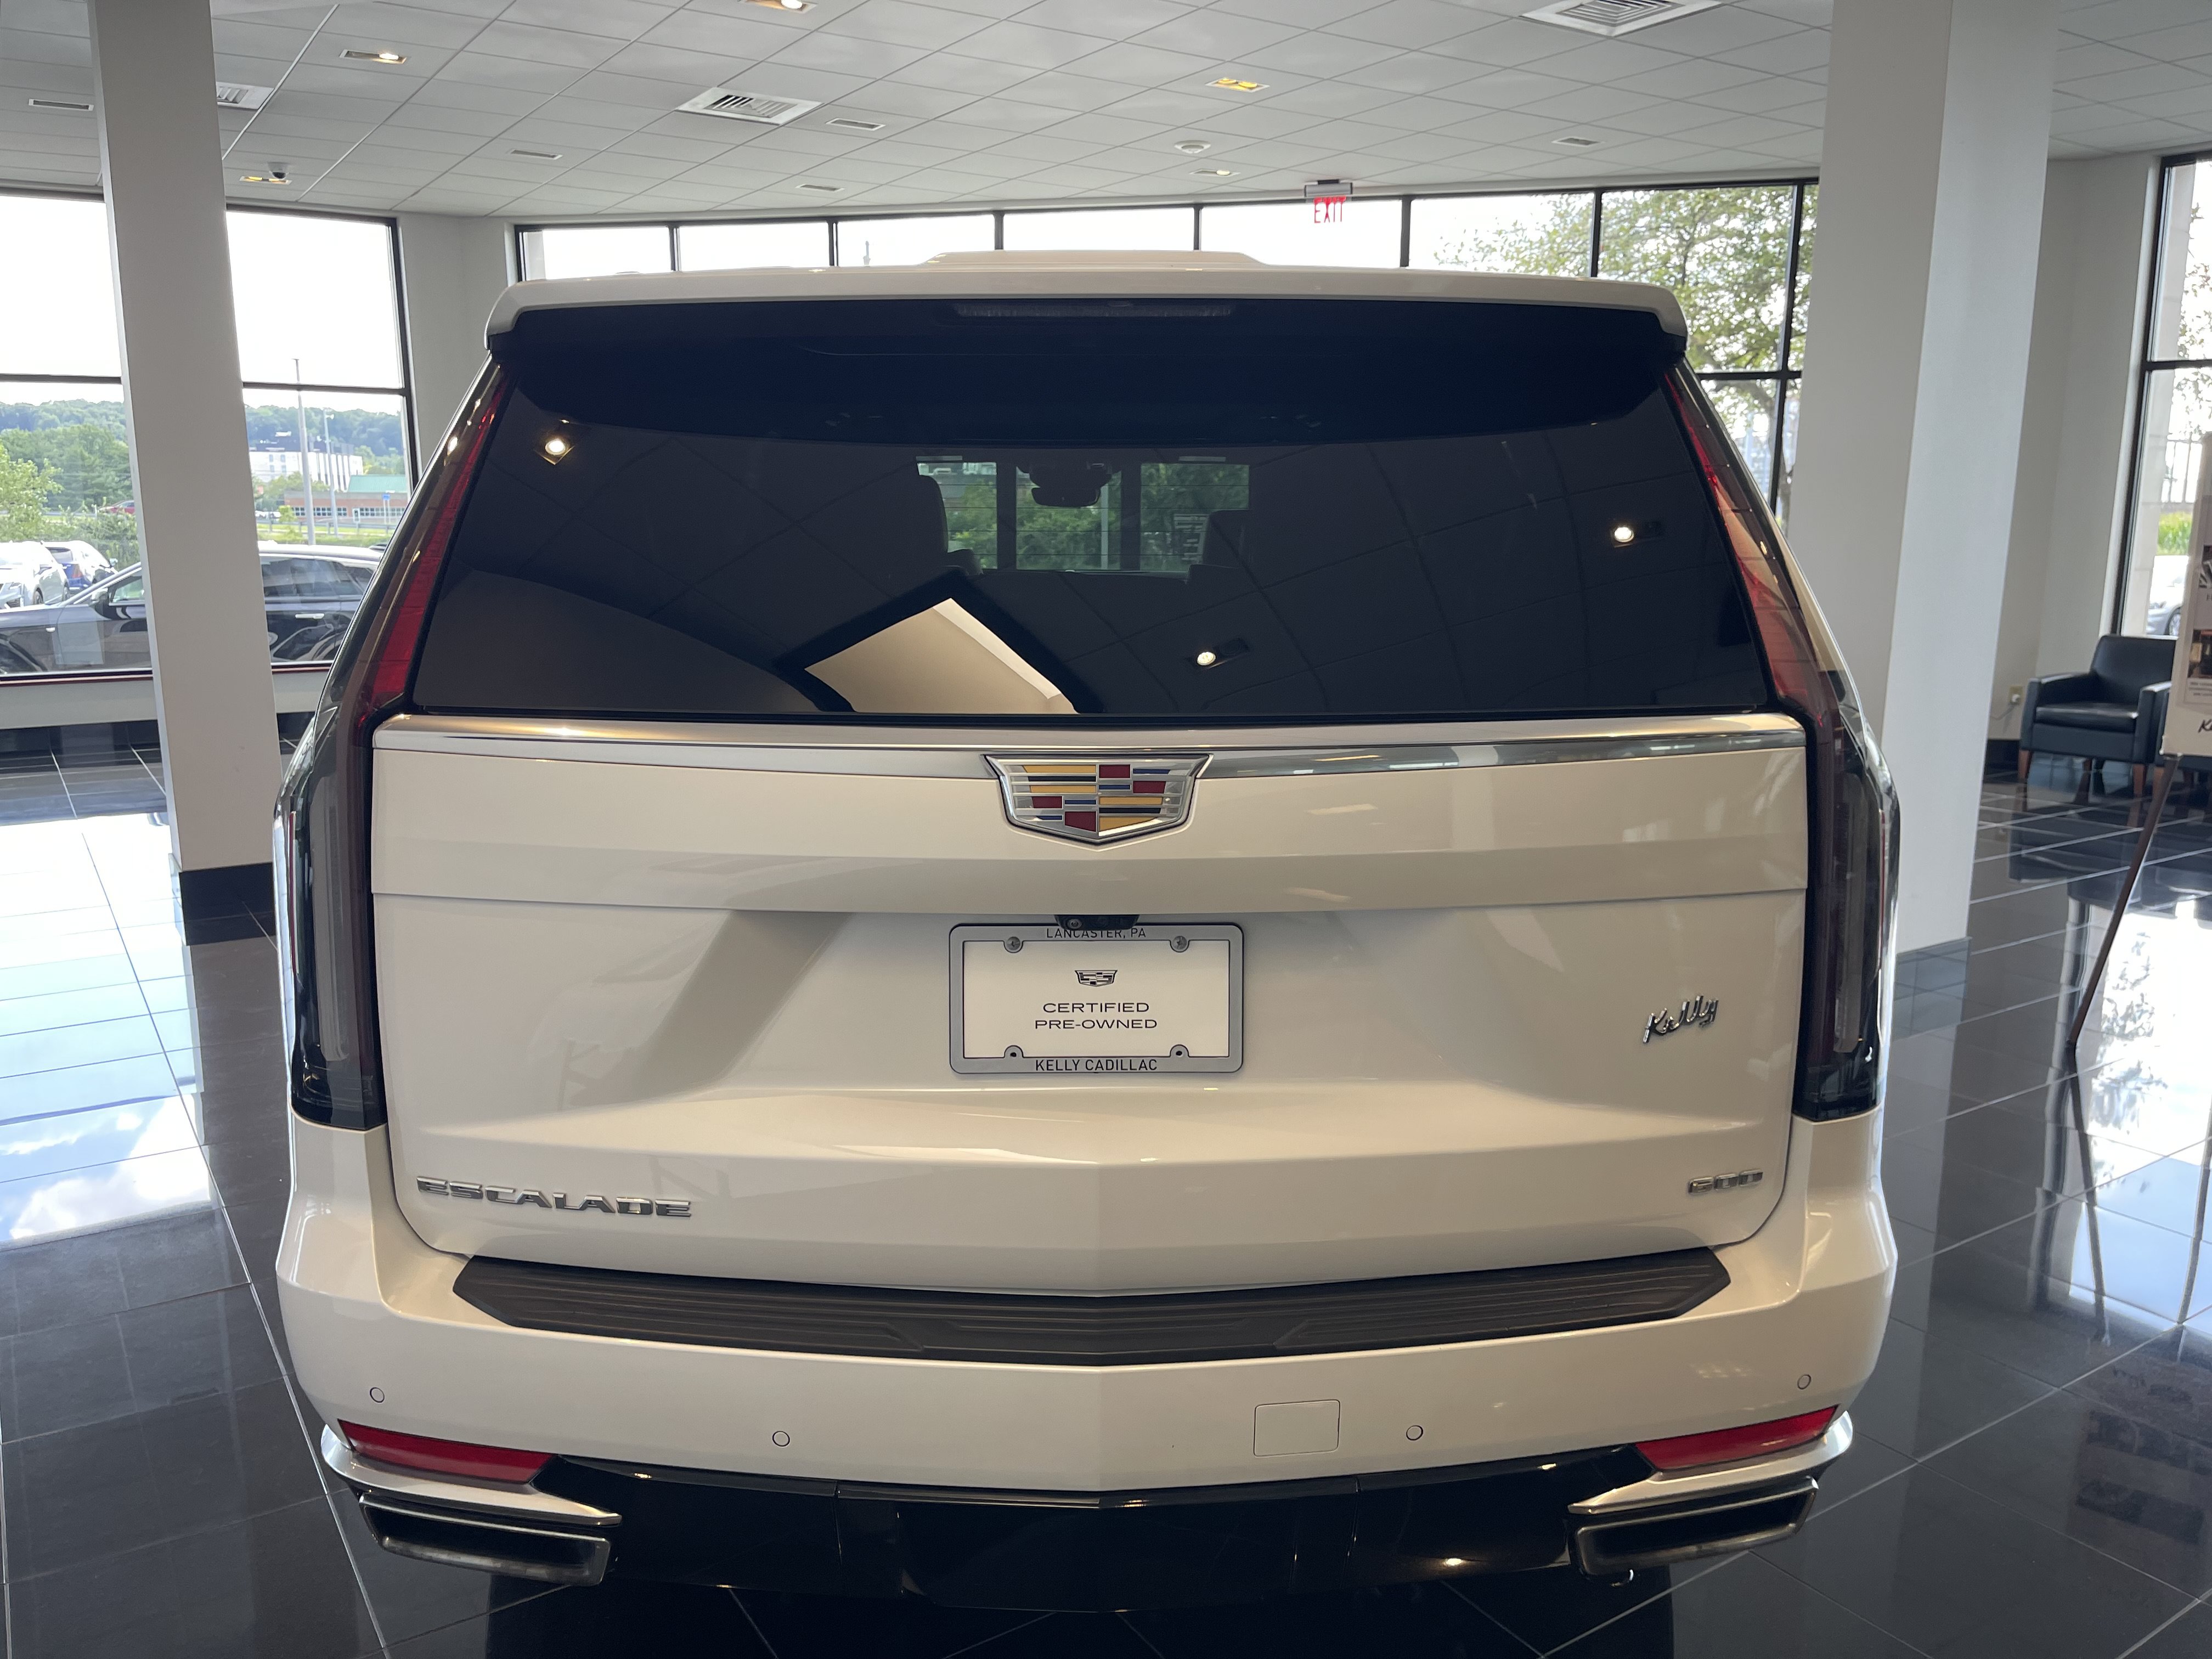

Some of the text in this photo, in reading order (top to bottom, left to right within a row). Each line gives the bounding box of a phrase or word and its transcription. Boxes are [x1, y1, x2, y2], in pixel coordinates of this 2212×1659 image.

[1313, 196, 1346, 223] EXIT
[1046, 928, 1146, 939] LANCASTER, PA
[1043, 1003, 1149, 1013] CERTIFIED
[1035, 1019, 1158, 1029] PRE-OWNED
[1642, 994, 1719, 1044] Kelly
[1035, 1059, 1157, 1071] KELLY CADILLAC
[1688, 1168, 1763, 1194] 600
[416, 1175, 692, 1218] ESCALADE
